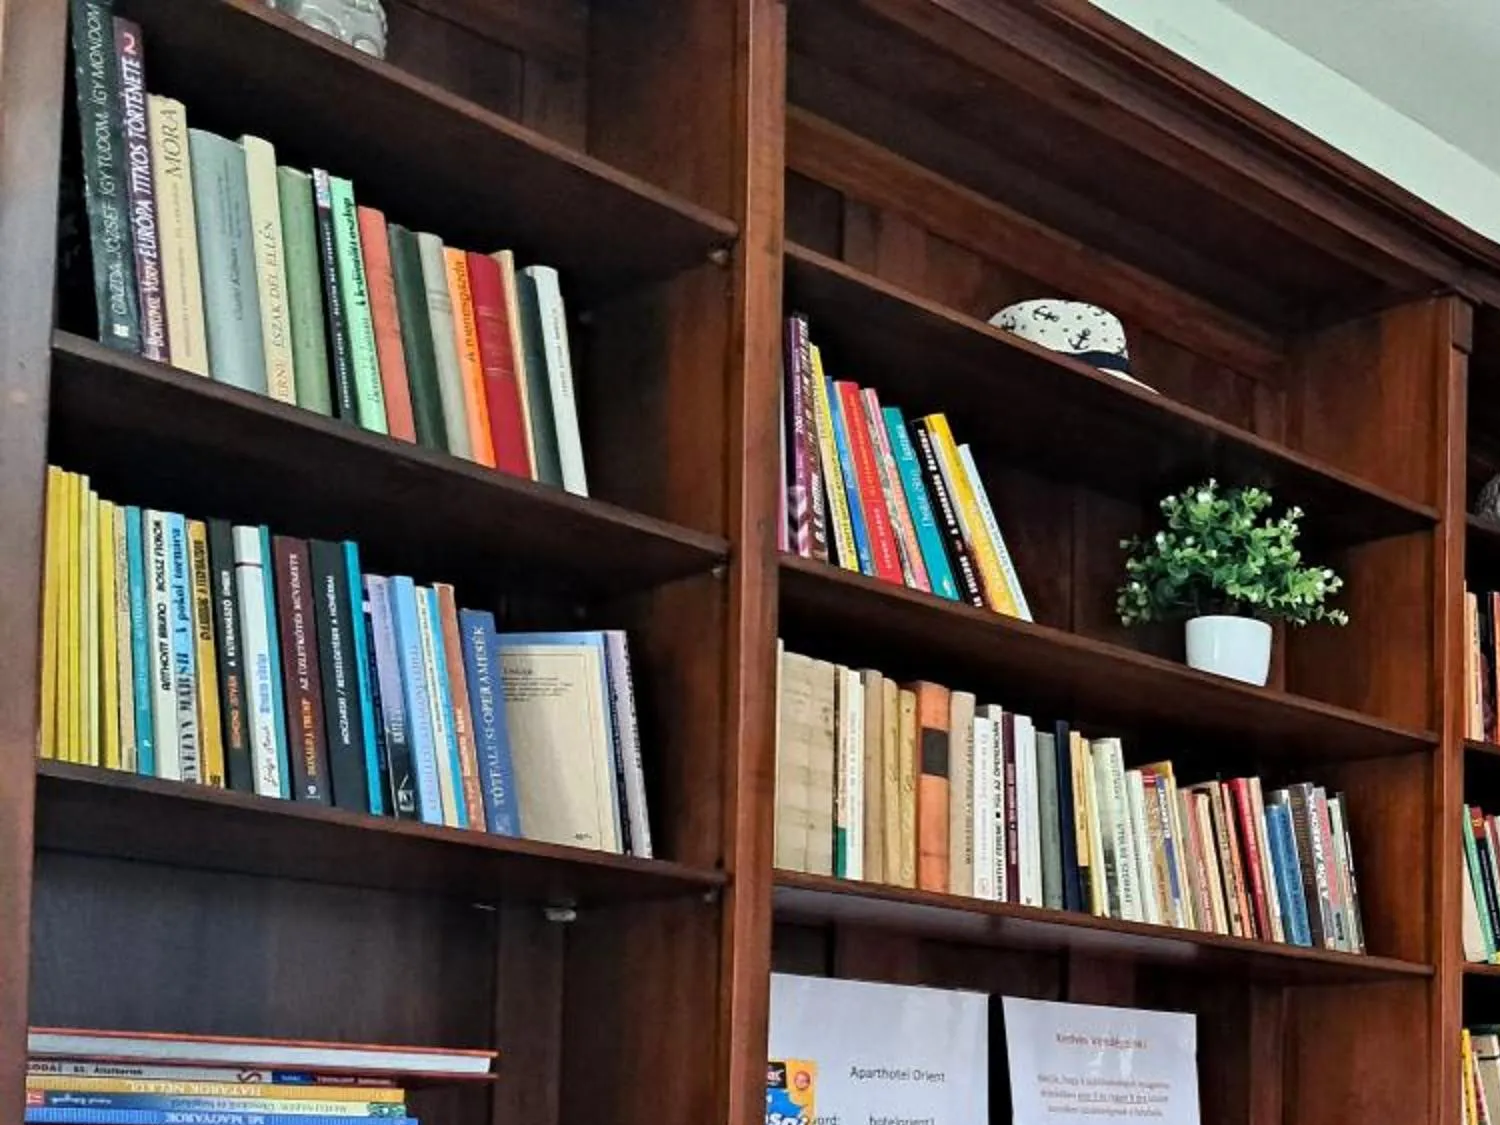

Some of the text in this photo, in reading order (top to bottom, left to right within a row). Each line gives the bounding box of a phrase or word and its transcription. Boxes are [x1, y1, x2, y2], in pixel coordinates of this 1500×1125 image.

[89, 3, 105, 78] MONDOM
[123, 56, 145, 139] TÖRTÉNETE
[131, 144, 152, 195] TITKOS
[160, 108, 182, 179] MÓRA
[134, 200, 157, 260] EURÓPA
[850, 1066, 946, 1083] Aparthotel Orient
